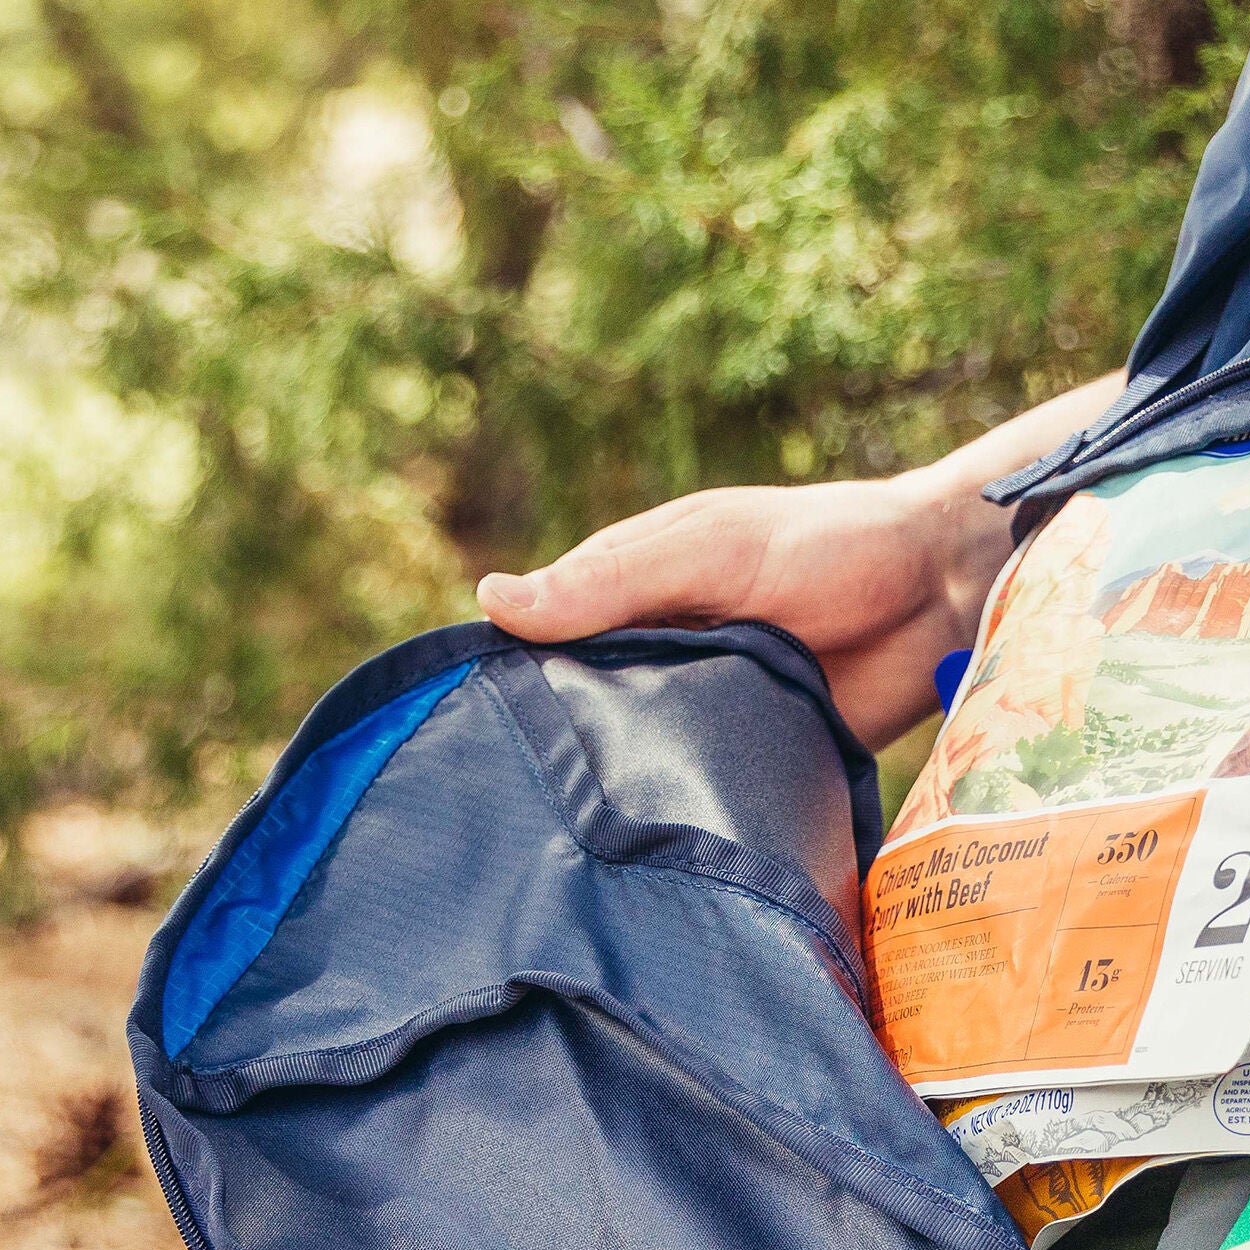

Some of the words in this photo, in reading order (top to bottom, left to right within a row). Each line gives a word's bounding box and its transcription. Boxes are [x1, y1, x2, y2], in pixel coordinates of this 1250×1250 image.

[1097, 829, 1158, 865] 350
[876, 860, 925, 900] Chiang
[925, 844, 962, 878] Mai
[962, 831, 1050, 869] Coconut
[1100, 873, 1138, 886] Calories
[868, 900, 903, 937] Curry
[901, 882, 943, 920] with
[946, 871, 993, 910] Beef
[895, 945, 917, 963] RICE
[915, 937, 963, 955] NOODLES
[963, 932, 991, 949] FROM
[965, 946, 998, 964] SWEET
[882, 975, 916, 993] YELLOW
[915, 969, 949, 986] CURRY
[949, 965, 978, 980] WITH
[978, 960, 1009, 977] ZESTY
[1175, 955, 1244, 985] SERVING
[1068, 1002, 1105, 1015] Protein
[970, 1109, 988, 1137] NET
[986, 1105, 1003, 1127] WT
[1001, 1099, 1020, 1119] 3.9
[1020, 1093, 1035, 1114] OZ
[1034, 1087, 1074, 1115] (110g)
